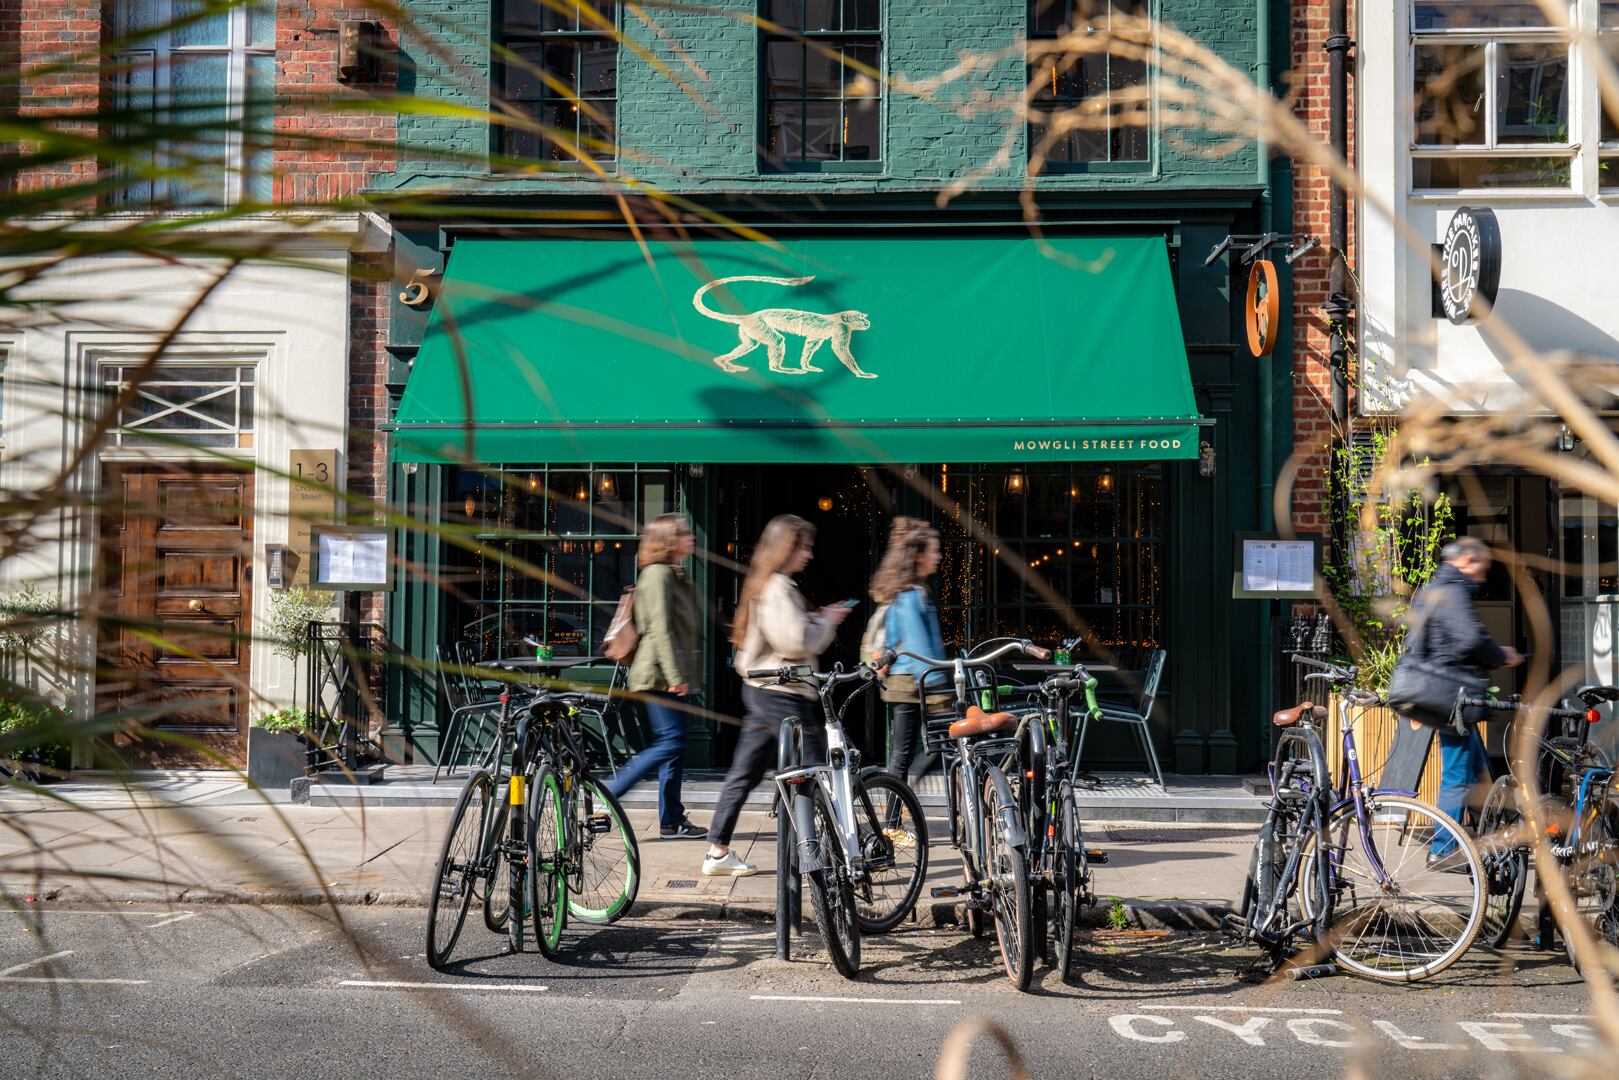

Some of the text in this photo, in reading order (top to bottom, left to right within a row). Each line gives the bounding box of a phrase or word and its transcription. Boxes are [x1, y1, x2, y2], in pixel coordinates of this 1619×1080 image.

[1442, 227, 1456, 261] THE
[1454, 213, 1479, 270] PANCAKES
[399, 268, 436, 305] 5
[1013, 439, 1182, 450] MOWGLI STREET FOOD
[296, 462, 329, 482] 1-3
